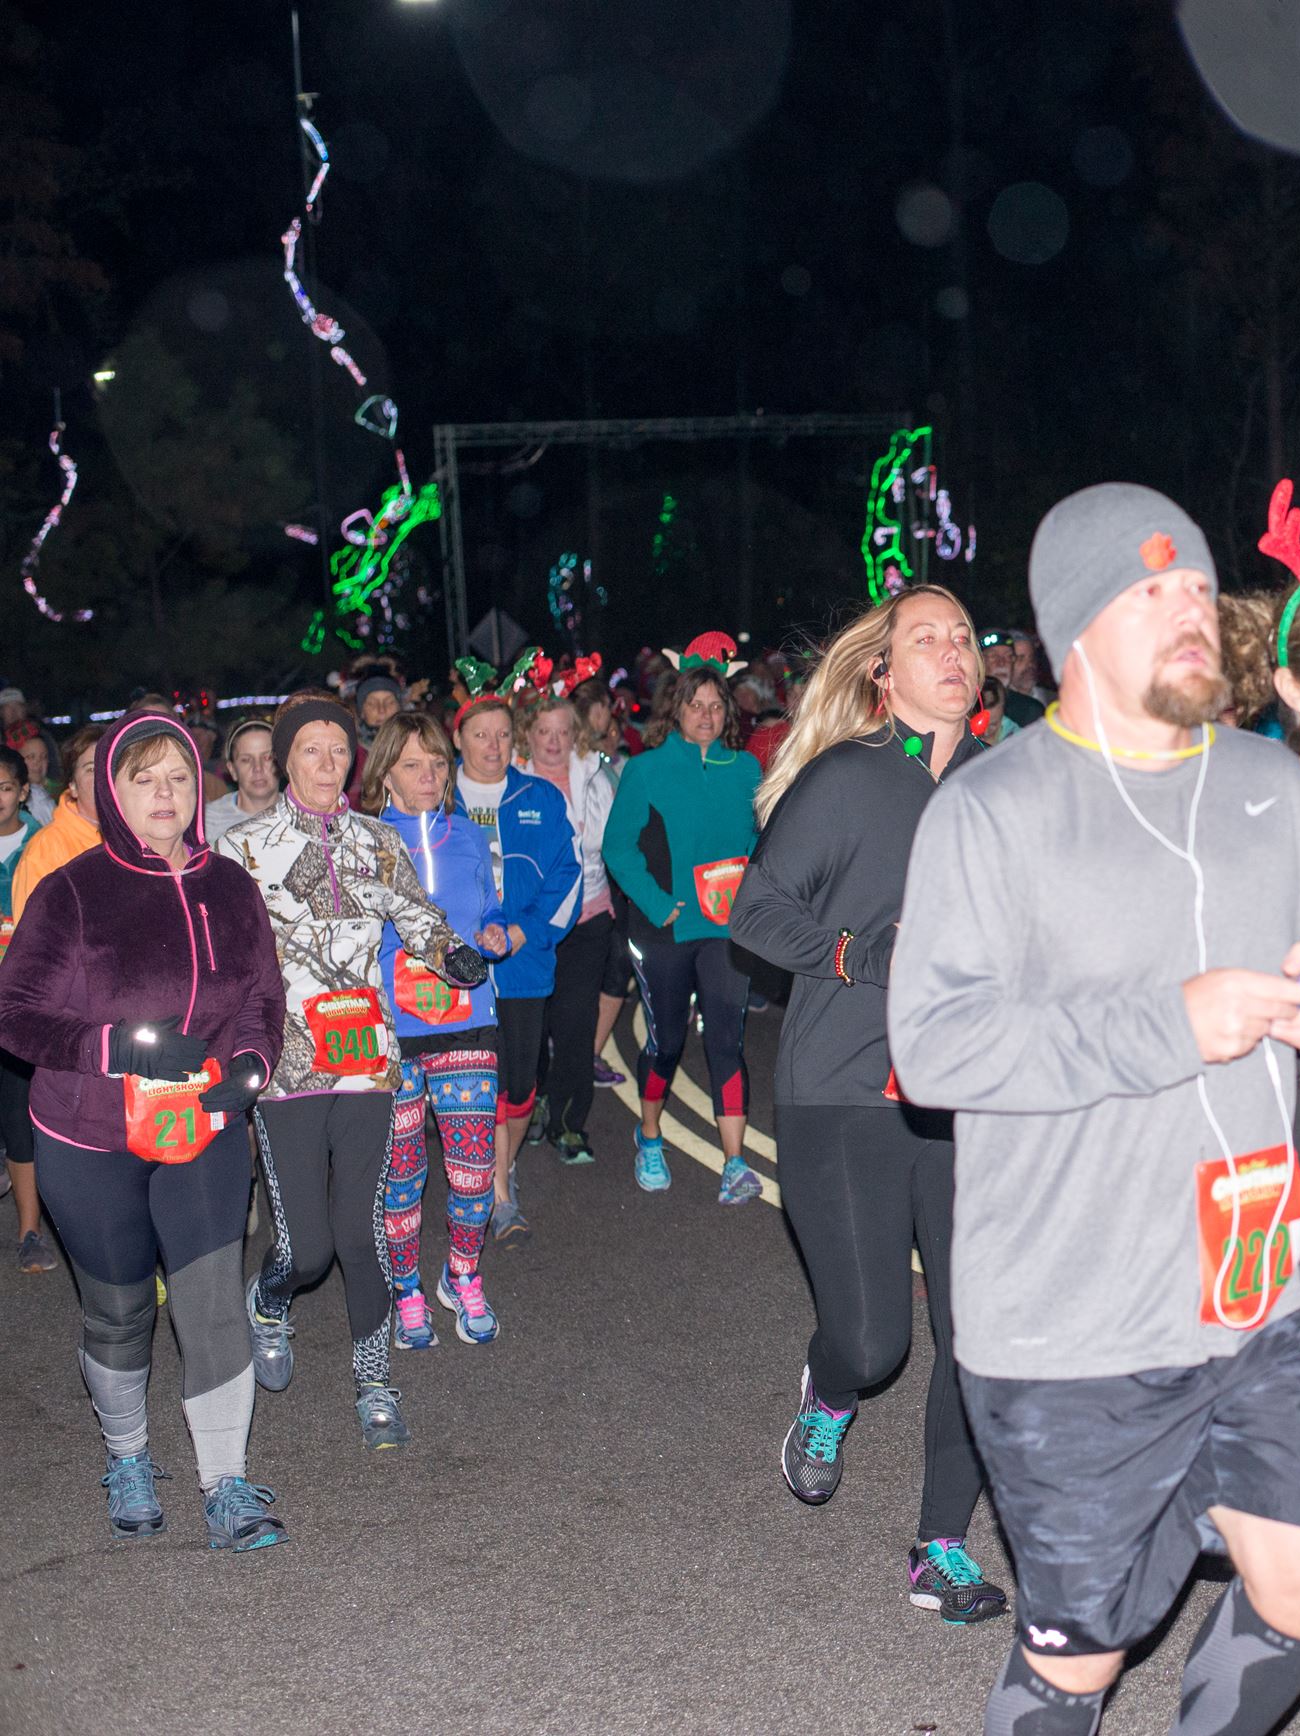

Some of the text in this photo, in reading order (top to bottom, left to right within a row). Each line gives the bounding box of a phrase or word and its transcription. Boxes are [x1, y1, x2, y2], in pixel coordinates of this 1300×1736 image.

[415, 981, 452, 1012] 56
[325, 1025, 379, 1064] 340
[147, 1085, 174, 1097] LIGHT
[175, 1082, 204, 1092] SHOW
[154, 1107, 196, 1149] 21
[1223, 1222, 1290, 1301] 222
